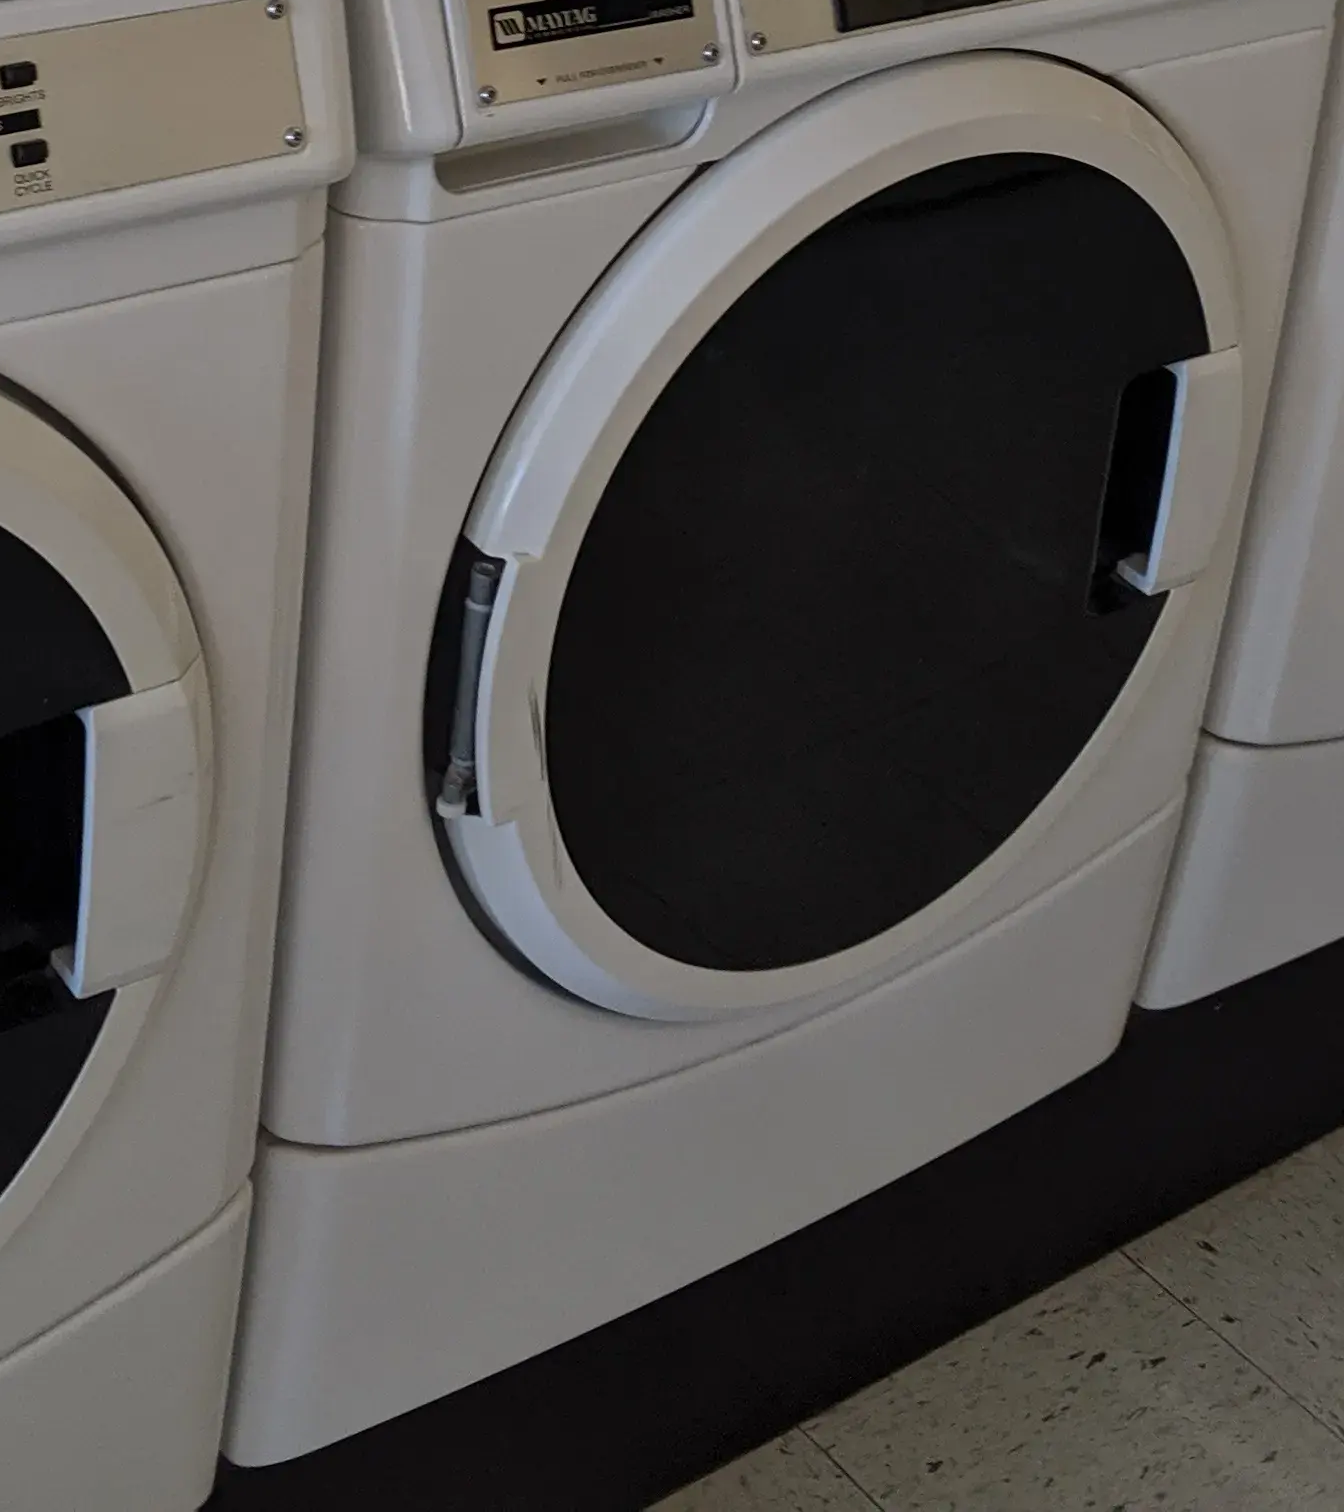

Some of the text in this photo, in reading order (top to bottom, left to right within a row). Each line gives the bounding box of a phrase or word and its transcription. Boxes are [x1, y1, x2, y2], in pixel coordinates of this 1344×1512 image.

[524, 6, 598, 33] MAYTAG
[14, 170, 50, 185] QUICK
[14, 180, 54, 197] CYCLE
